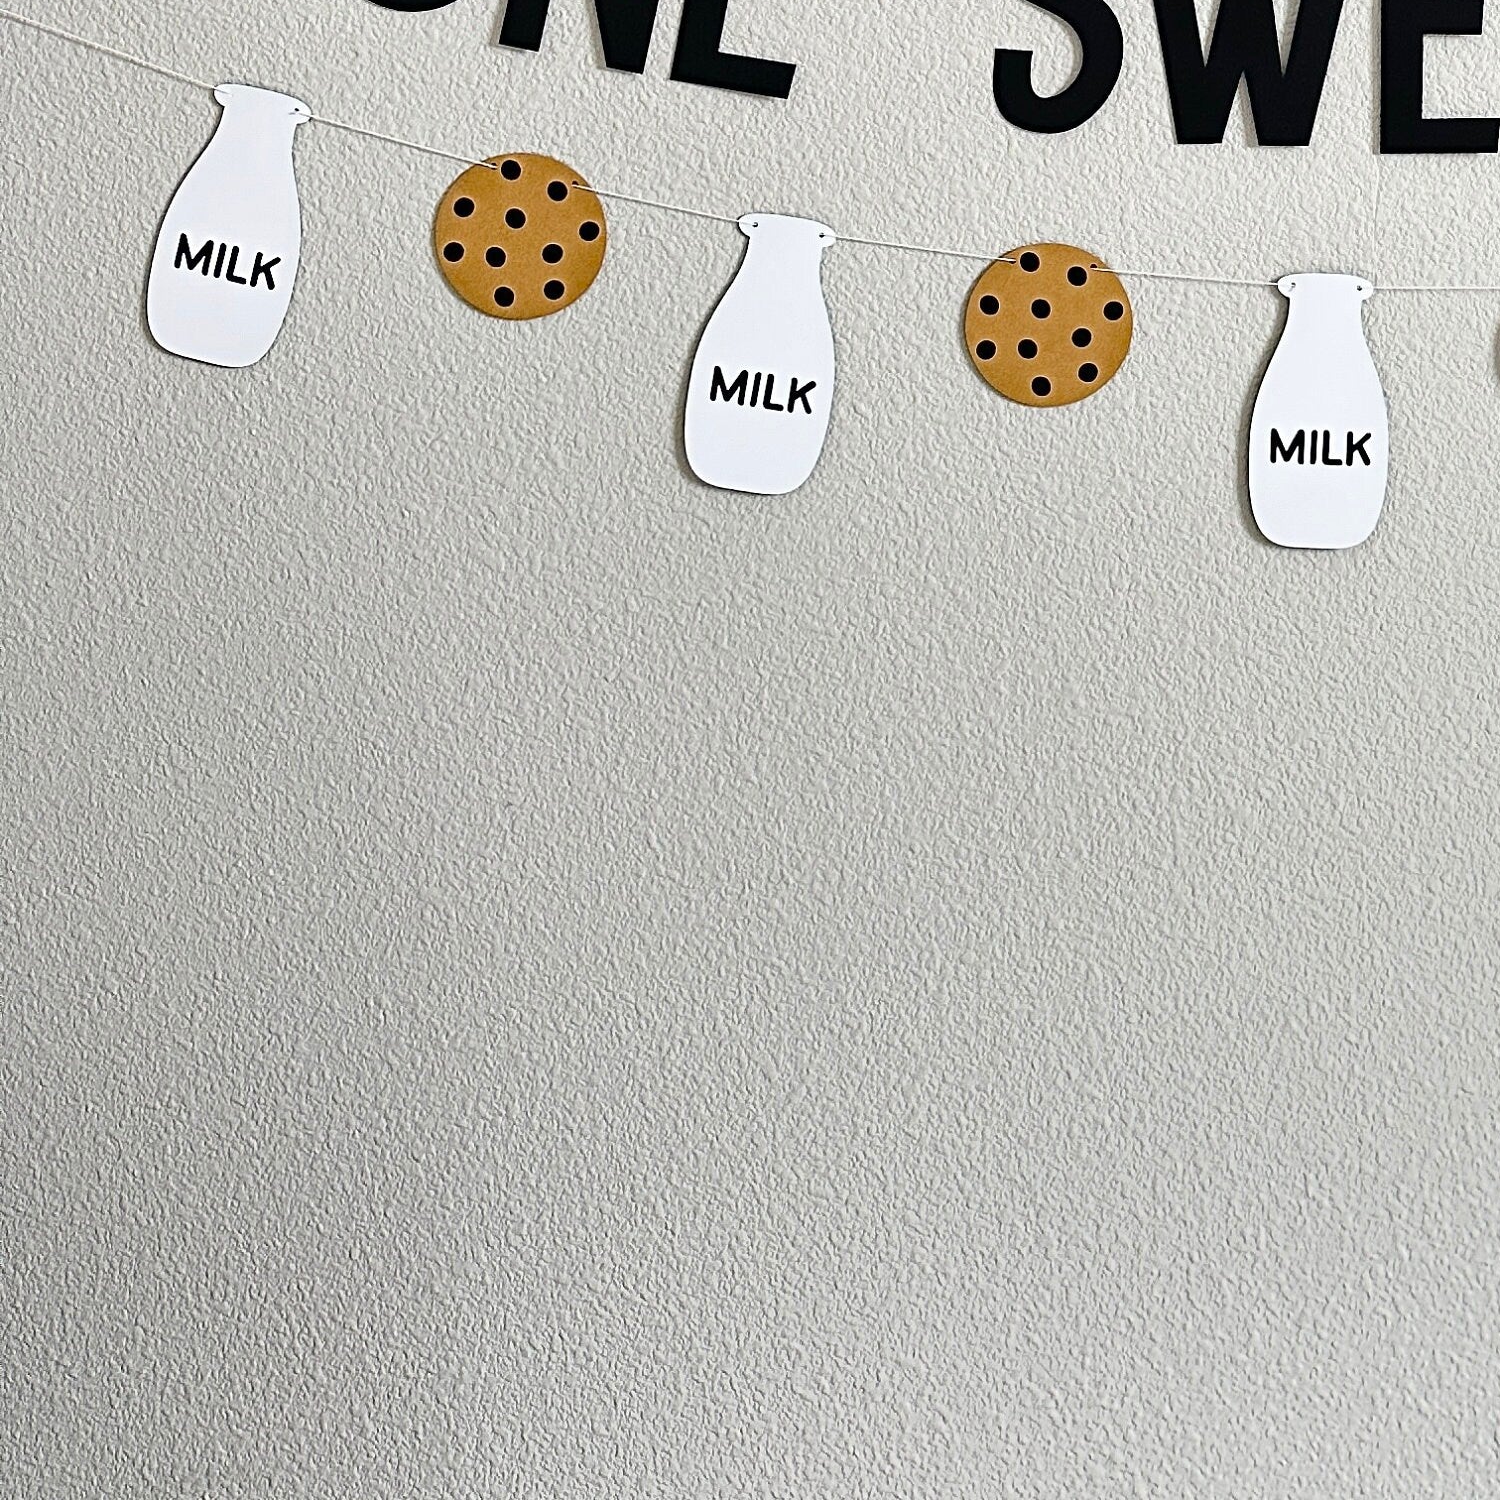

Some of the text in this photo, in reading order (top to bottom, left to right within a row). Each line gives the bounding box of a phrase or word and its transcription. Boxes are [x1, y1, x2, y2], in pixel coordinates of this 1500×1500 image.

[173, 232, 282, 292] MILK
[709, 365, 817, 415] MILK
[1270, 428, 1373, 467] MILK
